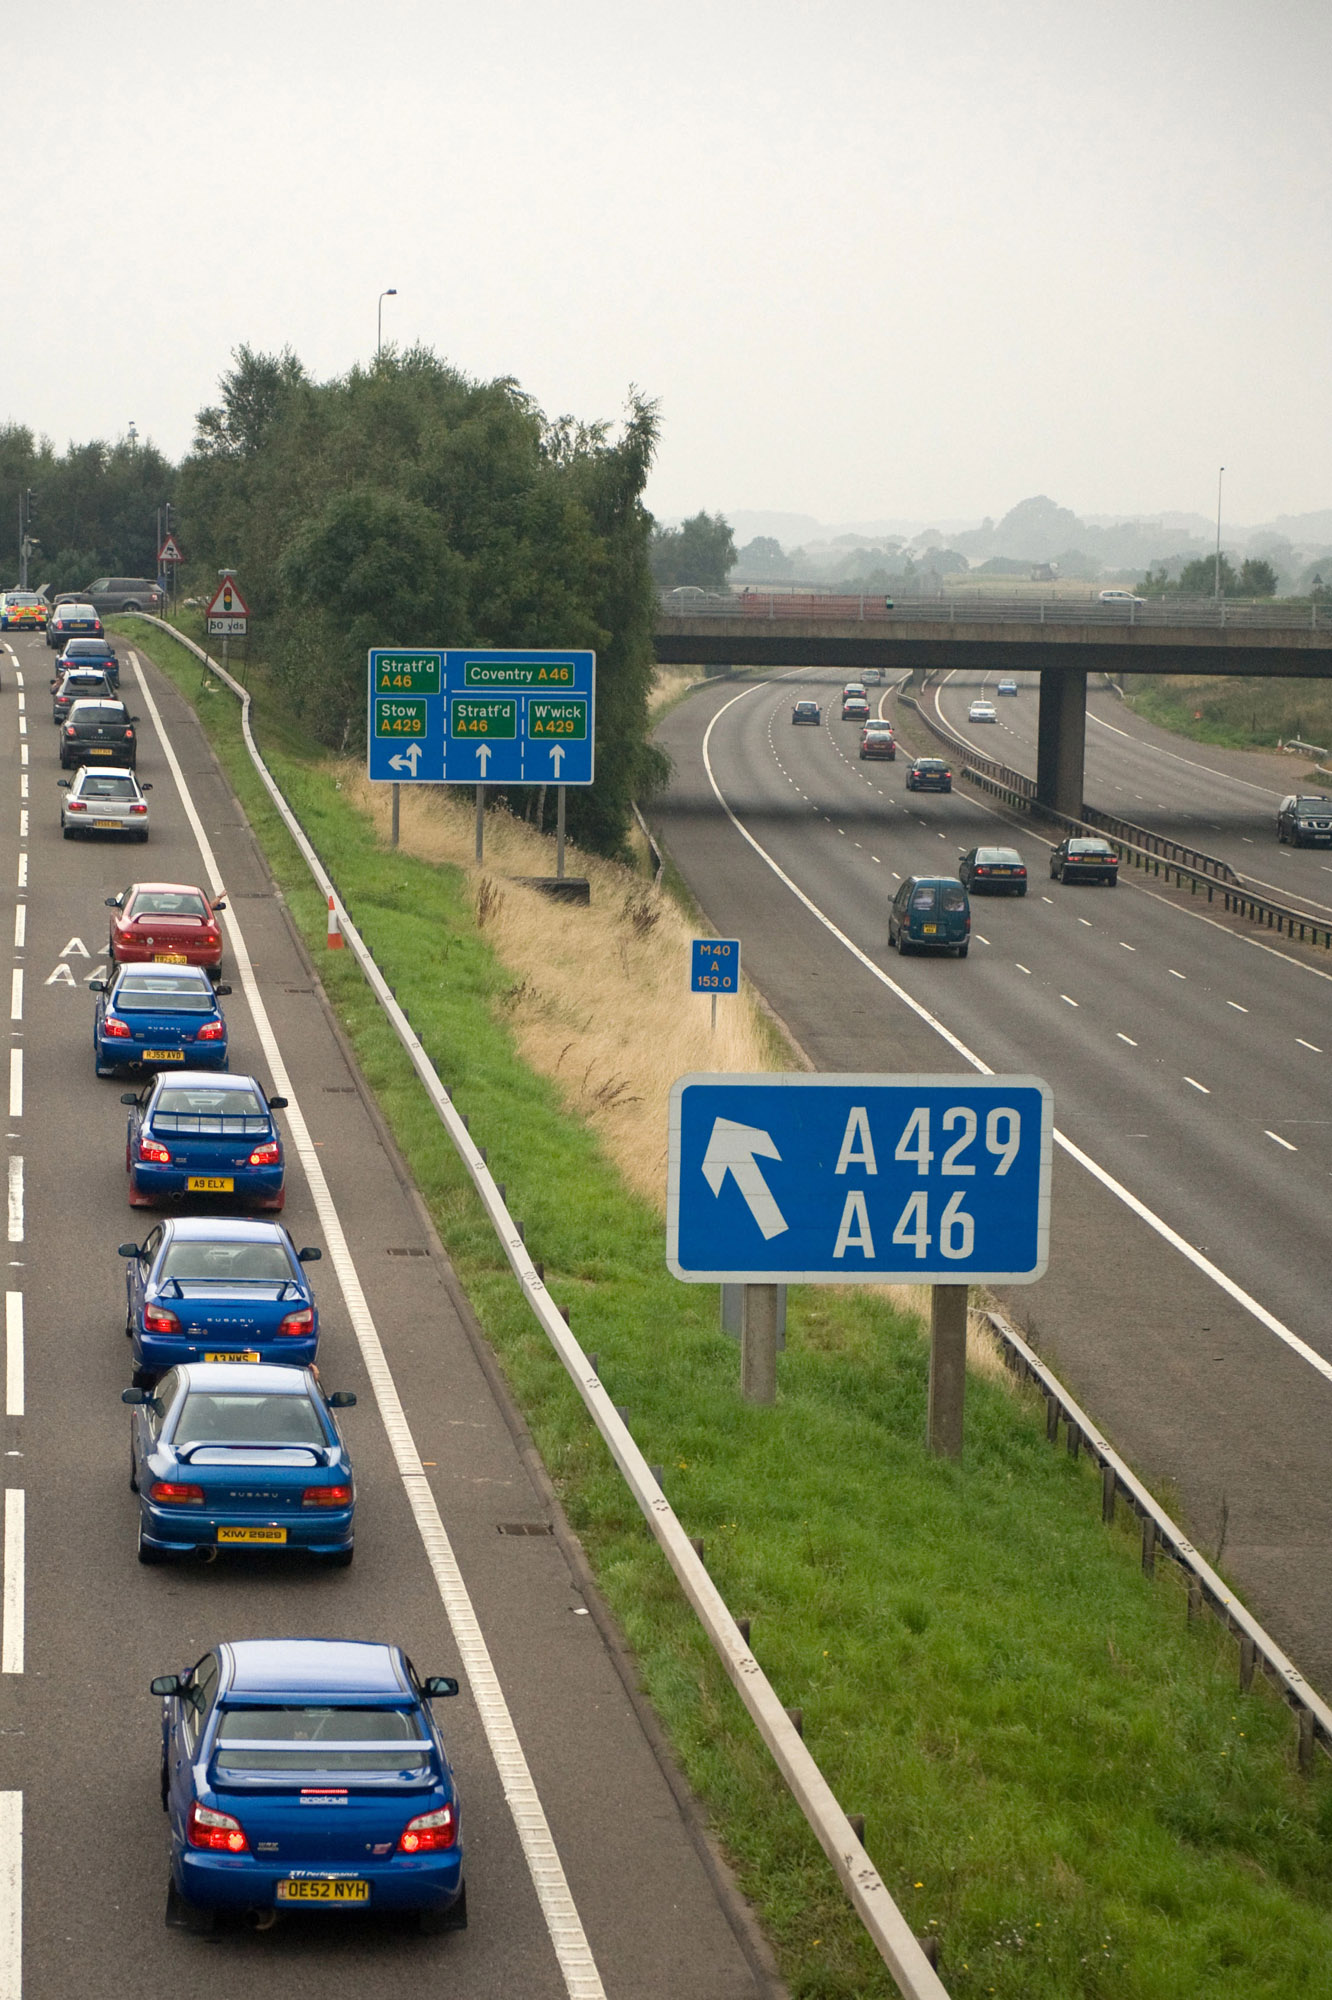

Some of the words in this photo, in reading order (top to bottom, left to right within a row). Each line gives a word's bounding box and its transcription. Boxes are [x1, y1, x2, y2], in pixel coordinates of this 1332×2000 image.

[227, 621, 244, 631] yds
[381, 660, 434, 673] Stratf'd
[470, 667, 533, 682] Coventry
[381, 704, 417, 716] Stow
[457, 704, 510, 717] Stratf'd
[534, 705, 581, 718] W'wick
[711, 961, 720, 971] A
[698, 976, 731, 988] 153.0
[193, 1179, 205, 1188] A9
[207, 1179, 225, 1188] ELX
[222, 1530, 246, 1538] XIW
[334, 1883, 366, 1897] NYH
